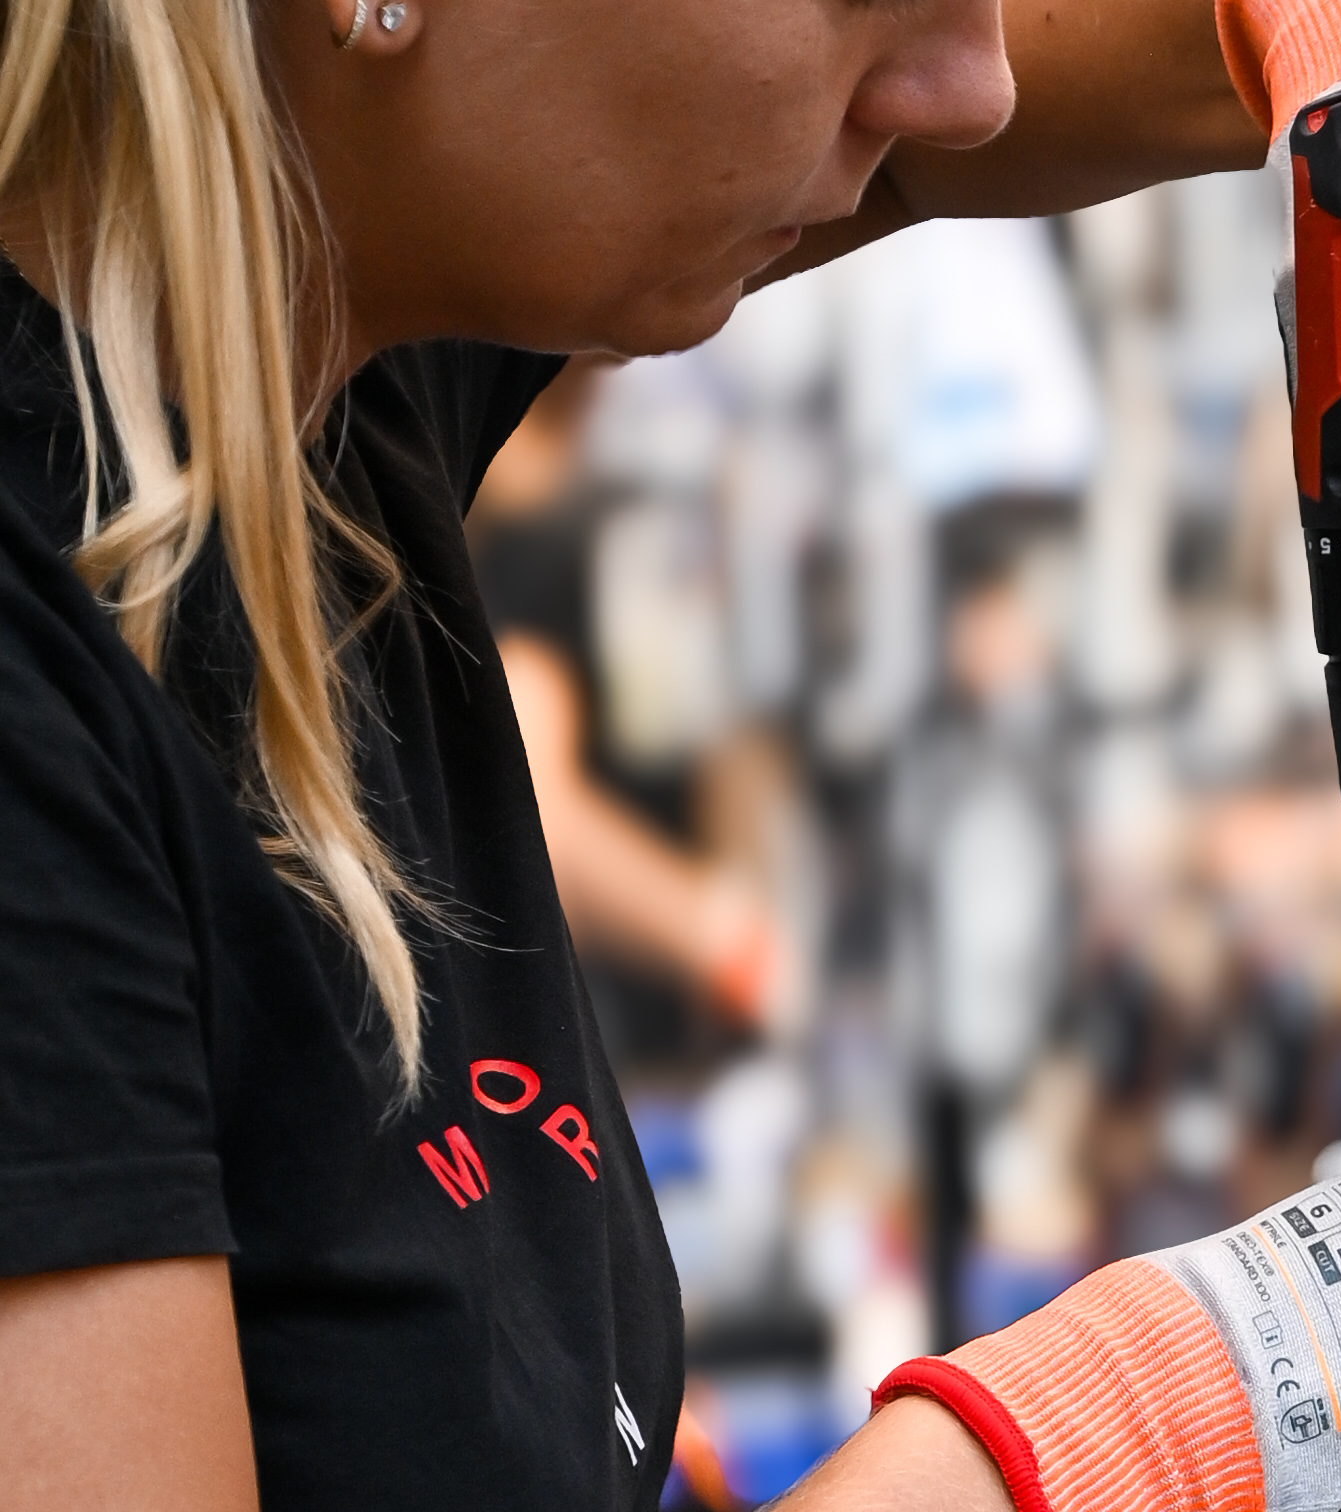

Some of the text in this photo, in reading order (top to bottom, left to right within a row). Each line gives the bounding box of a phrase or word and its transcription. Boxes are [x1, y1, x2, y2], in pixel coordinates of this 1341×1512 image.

[1309, 1203, 1333, 1219] 6
[1315, 1249, 1336, 1274] CUT
[1270, 1357, 1301, 1399] CE
